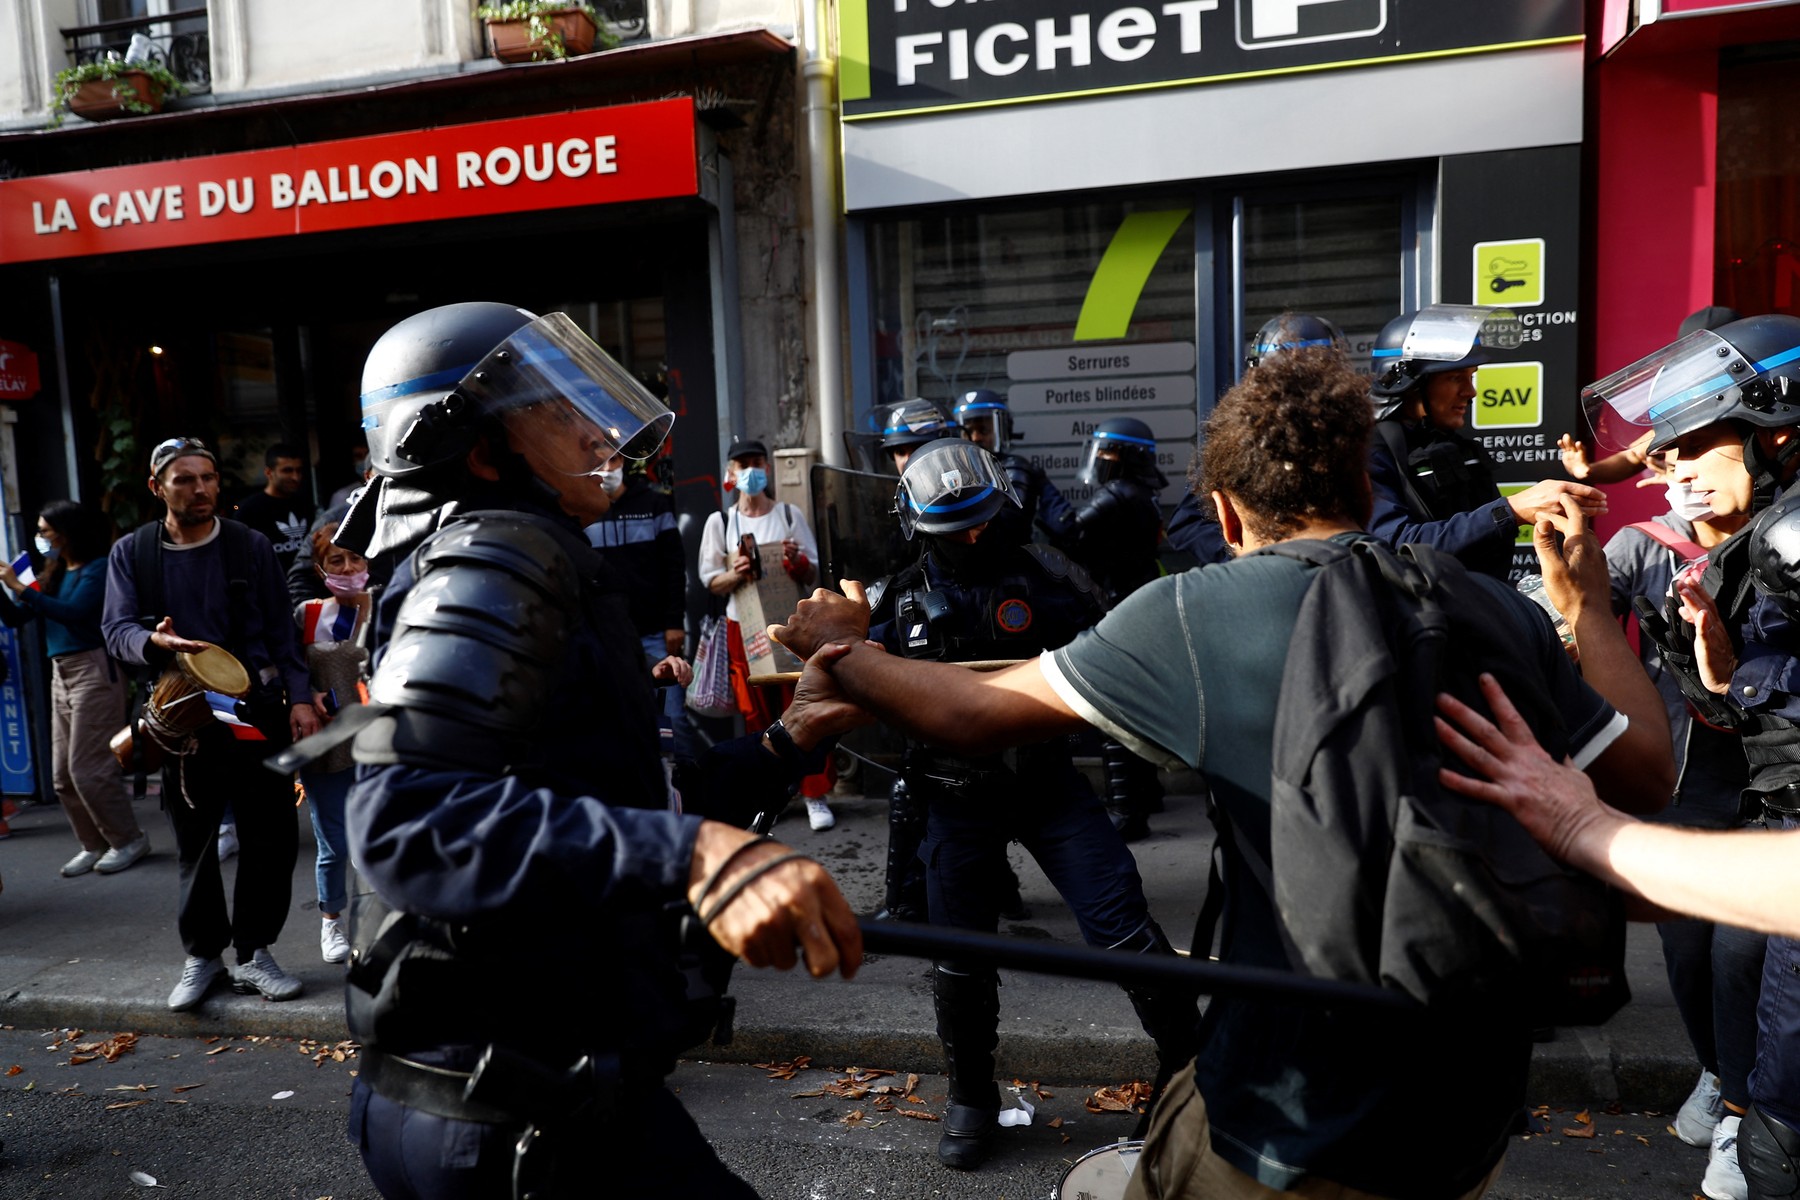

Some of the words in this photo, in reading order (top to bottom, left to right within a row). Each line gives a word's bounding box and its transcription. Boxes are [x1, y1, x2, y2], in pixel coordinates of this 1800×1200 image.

[32, 198, 77, 235] LA
[90, 186, 184, 228] CAVE
[199, 177, 254, 217] DU
[271, 156, 438, 209] BALLON
[456, 136, 618, 189] ROUGE
[1068, 355, 1130, 371] Serrures
[1046, 390, 1090, 403] Portes
[1095, 386, 1156, 402] blindées
[1482, 387, 1532, 408] SAV
